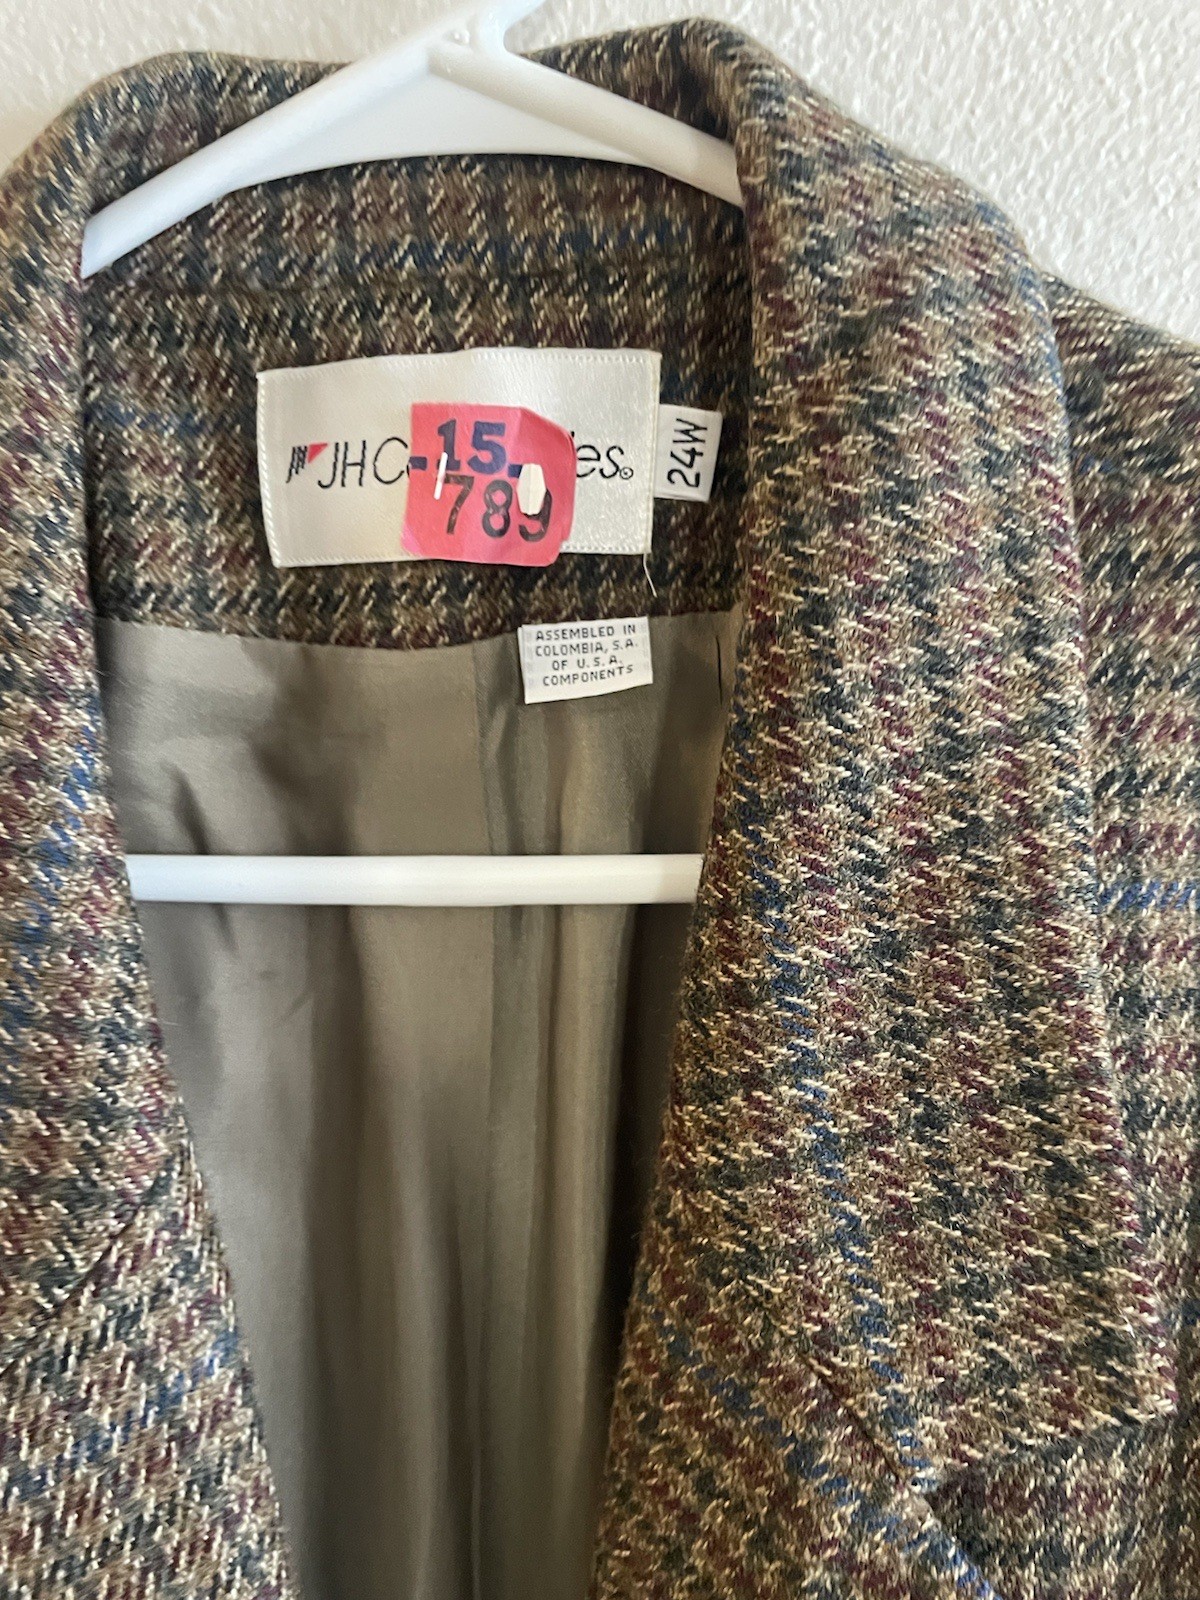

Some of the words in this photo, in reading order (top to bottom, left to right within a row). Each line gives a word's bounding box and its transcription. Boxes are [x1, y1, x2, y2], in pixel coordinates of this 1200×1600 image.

[666, 418, 708, 488] 24W
[536, 625, 615, 641] ASSEMBLED
[622, 624, 636, 636] IN
[535, 642, 608, 657] COLOMBIA,
[551, 660, 568, 672] OF
[542, 664, 634, 687] COMPONENTS
